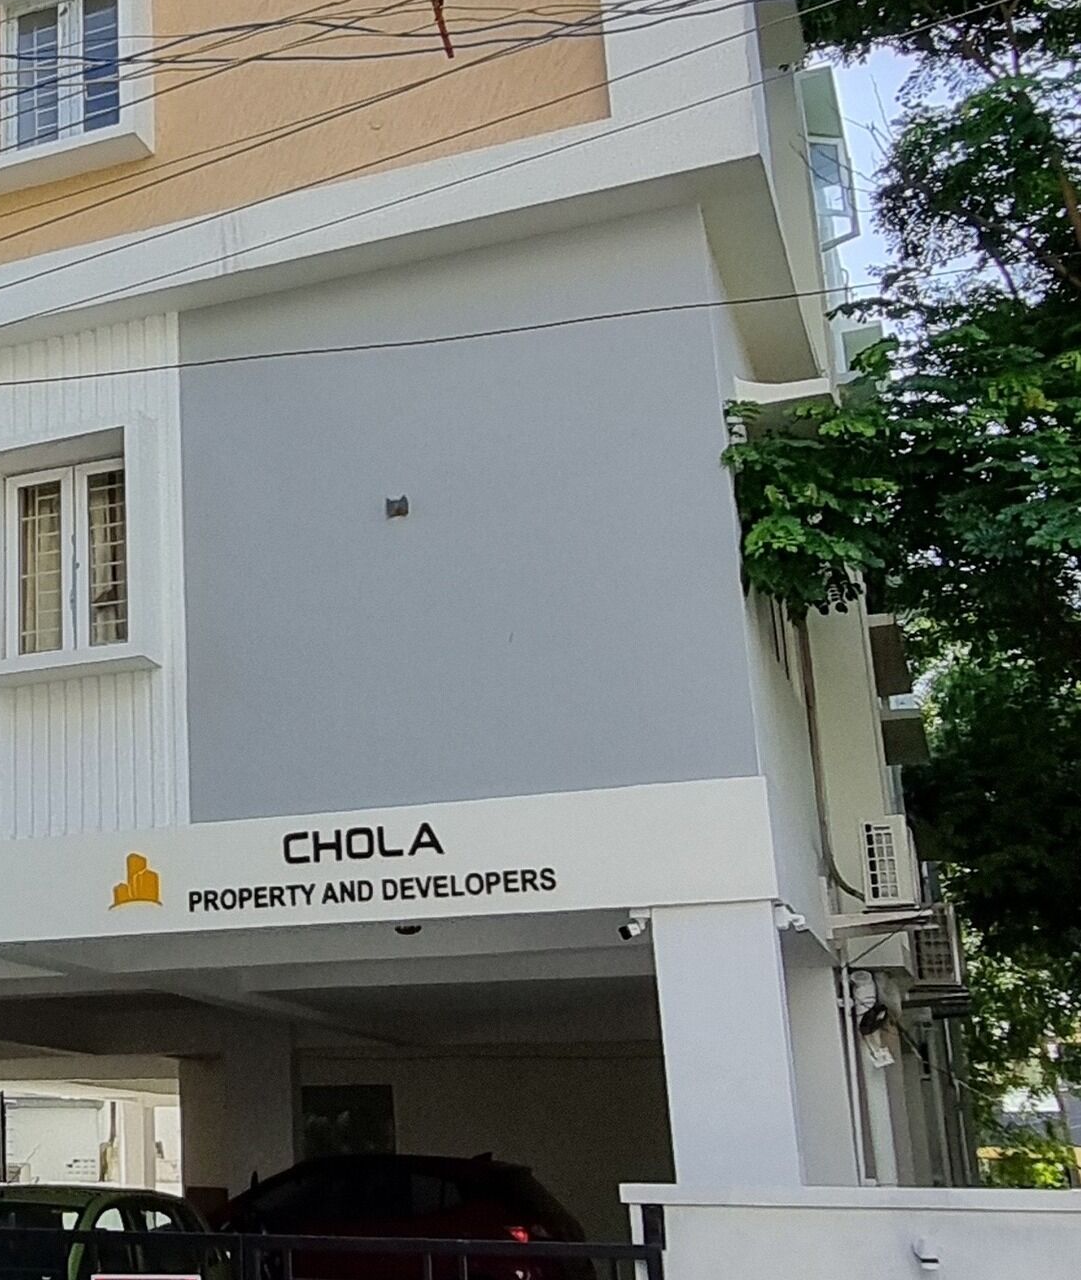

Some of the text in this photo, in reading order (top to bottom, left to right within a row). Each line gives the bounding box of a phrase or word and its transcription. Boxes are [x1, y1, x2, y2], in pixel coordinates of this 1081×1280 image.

[283, 822, 445, 864] CHOLA
[188, 868, 557, 912] PROPERTY AND DEVELOPERS
